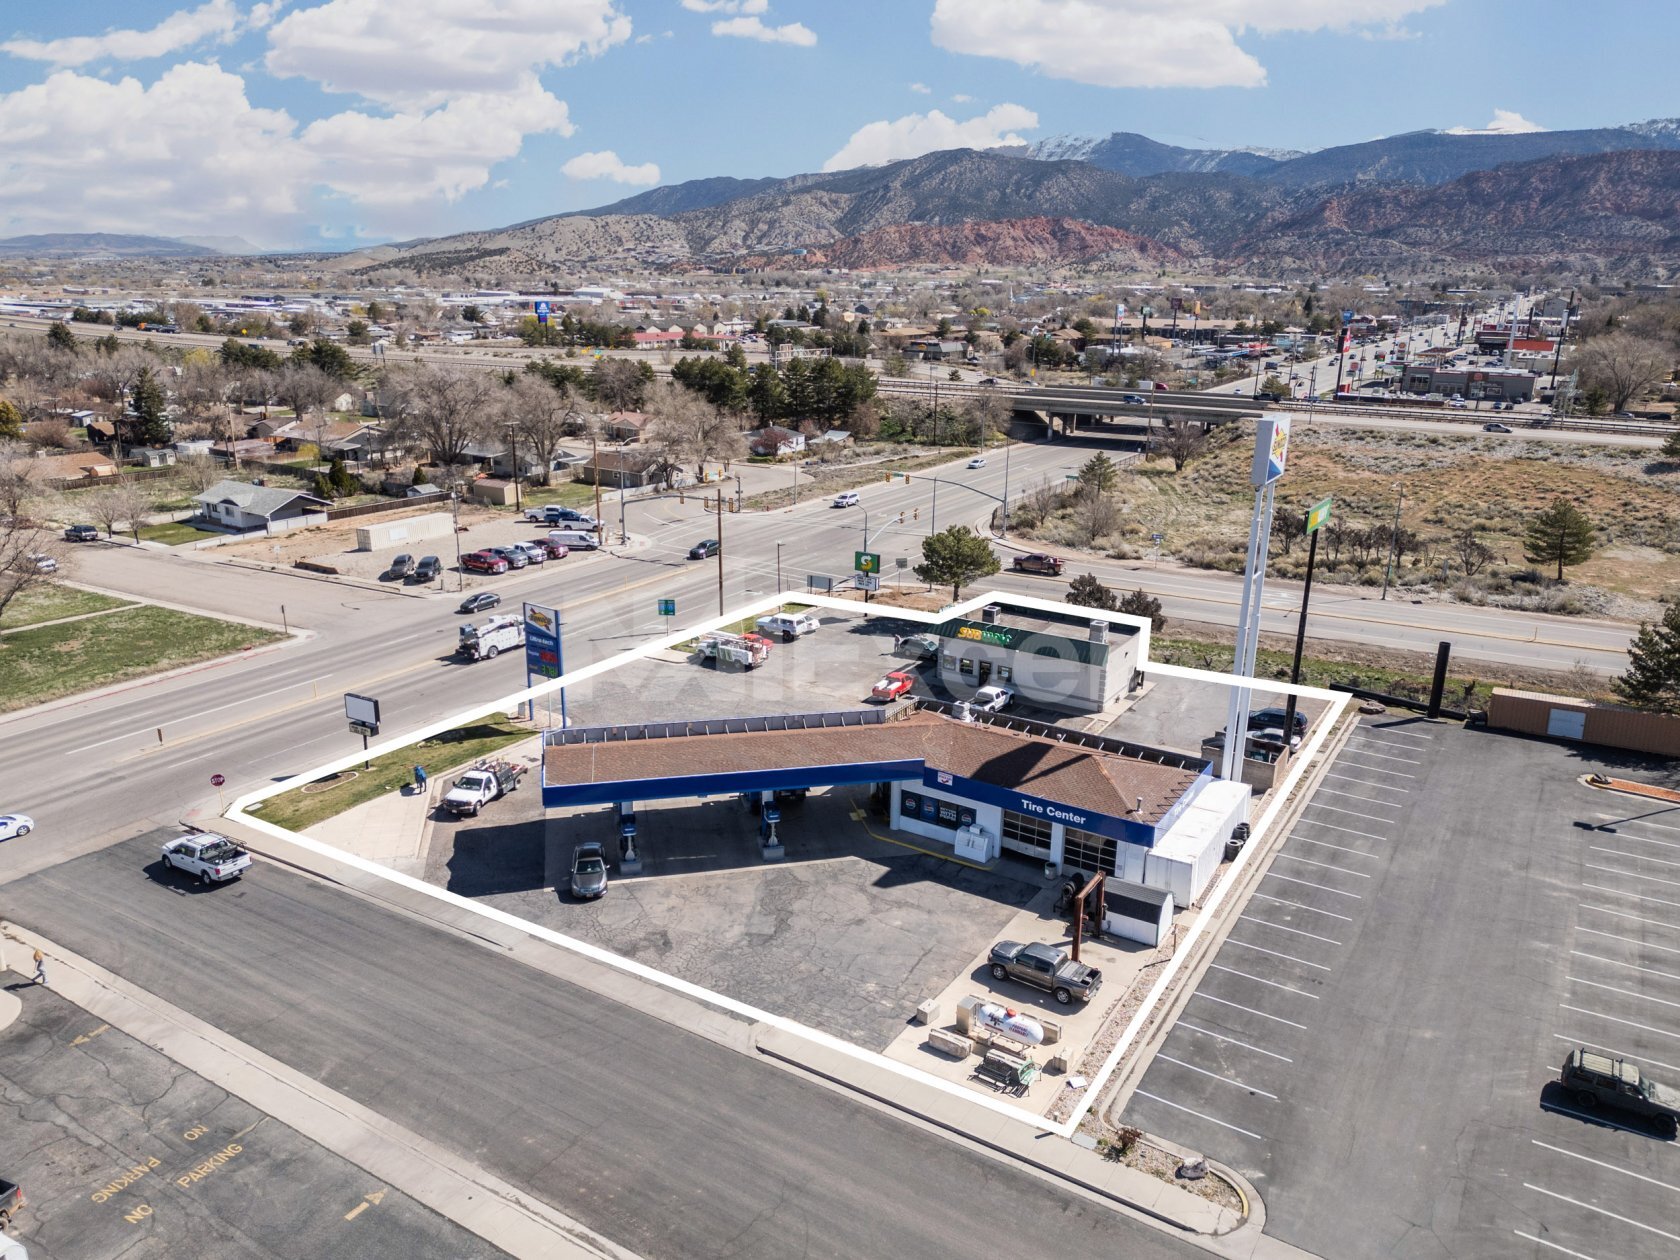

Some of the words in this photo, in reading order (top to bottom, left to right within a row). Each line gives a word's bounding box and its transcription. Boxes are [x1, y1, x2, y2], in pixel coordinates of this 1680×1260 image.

[957, 627, 1013, 646] SUBWAY
[211, 776, 224, 784] STOP
[1021, 799, 1043, 813] Tire
[1046, 806, 1086, 824] Center
[91, 1157, 161, 1203] PARKING
[124, 1204, 155, 1223] NO
[177, 1143, 242, 1188] PARKING
